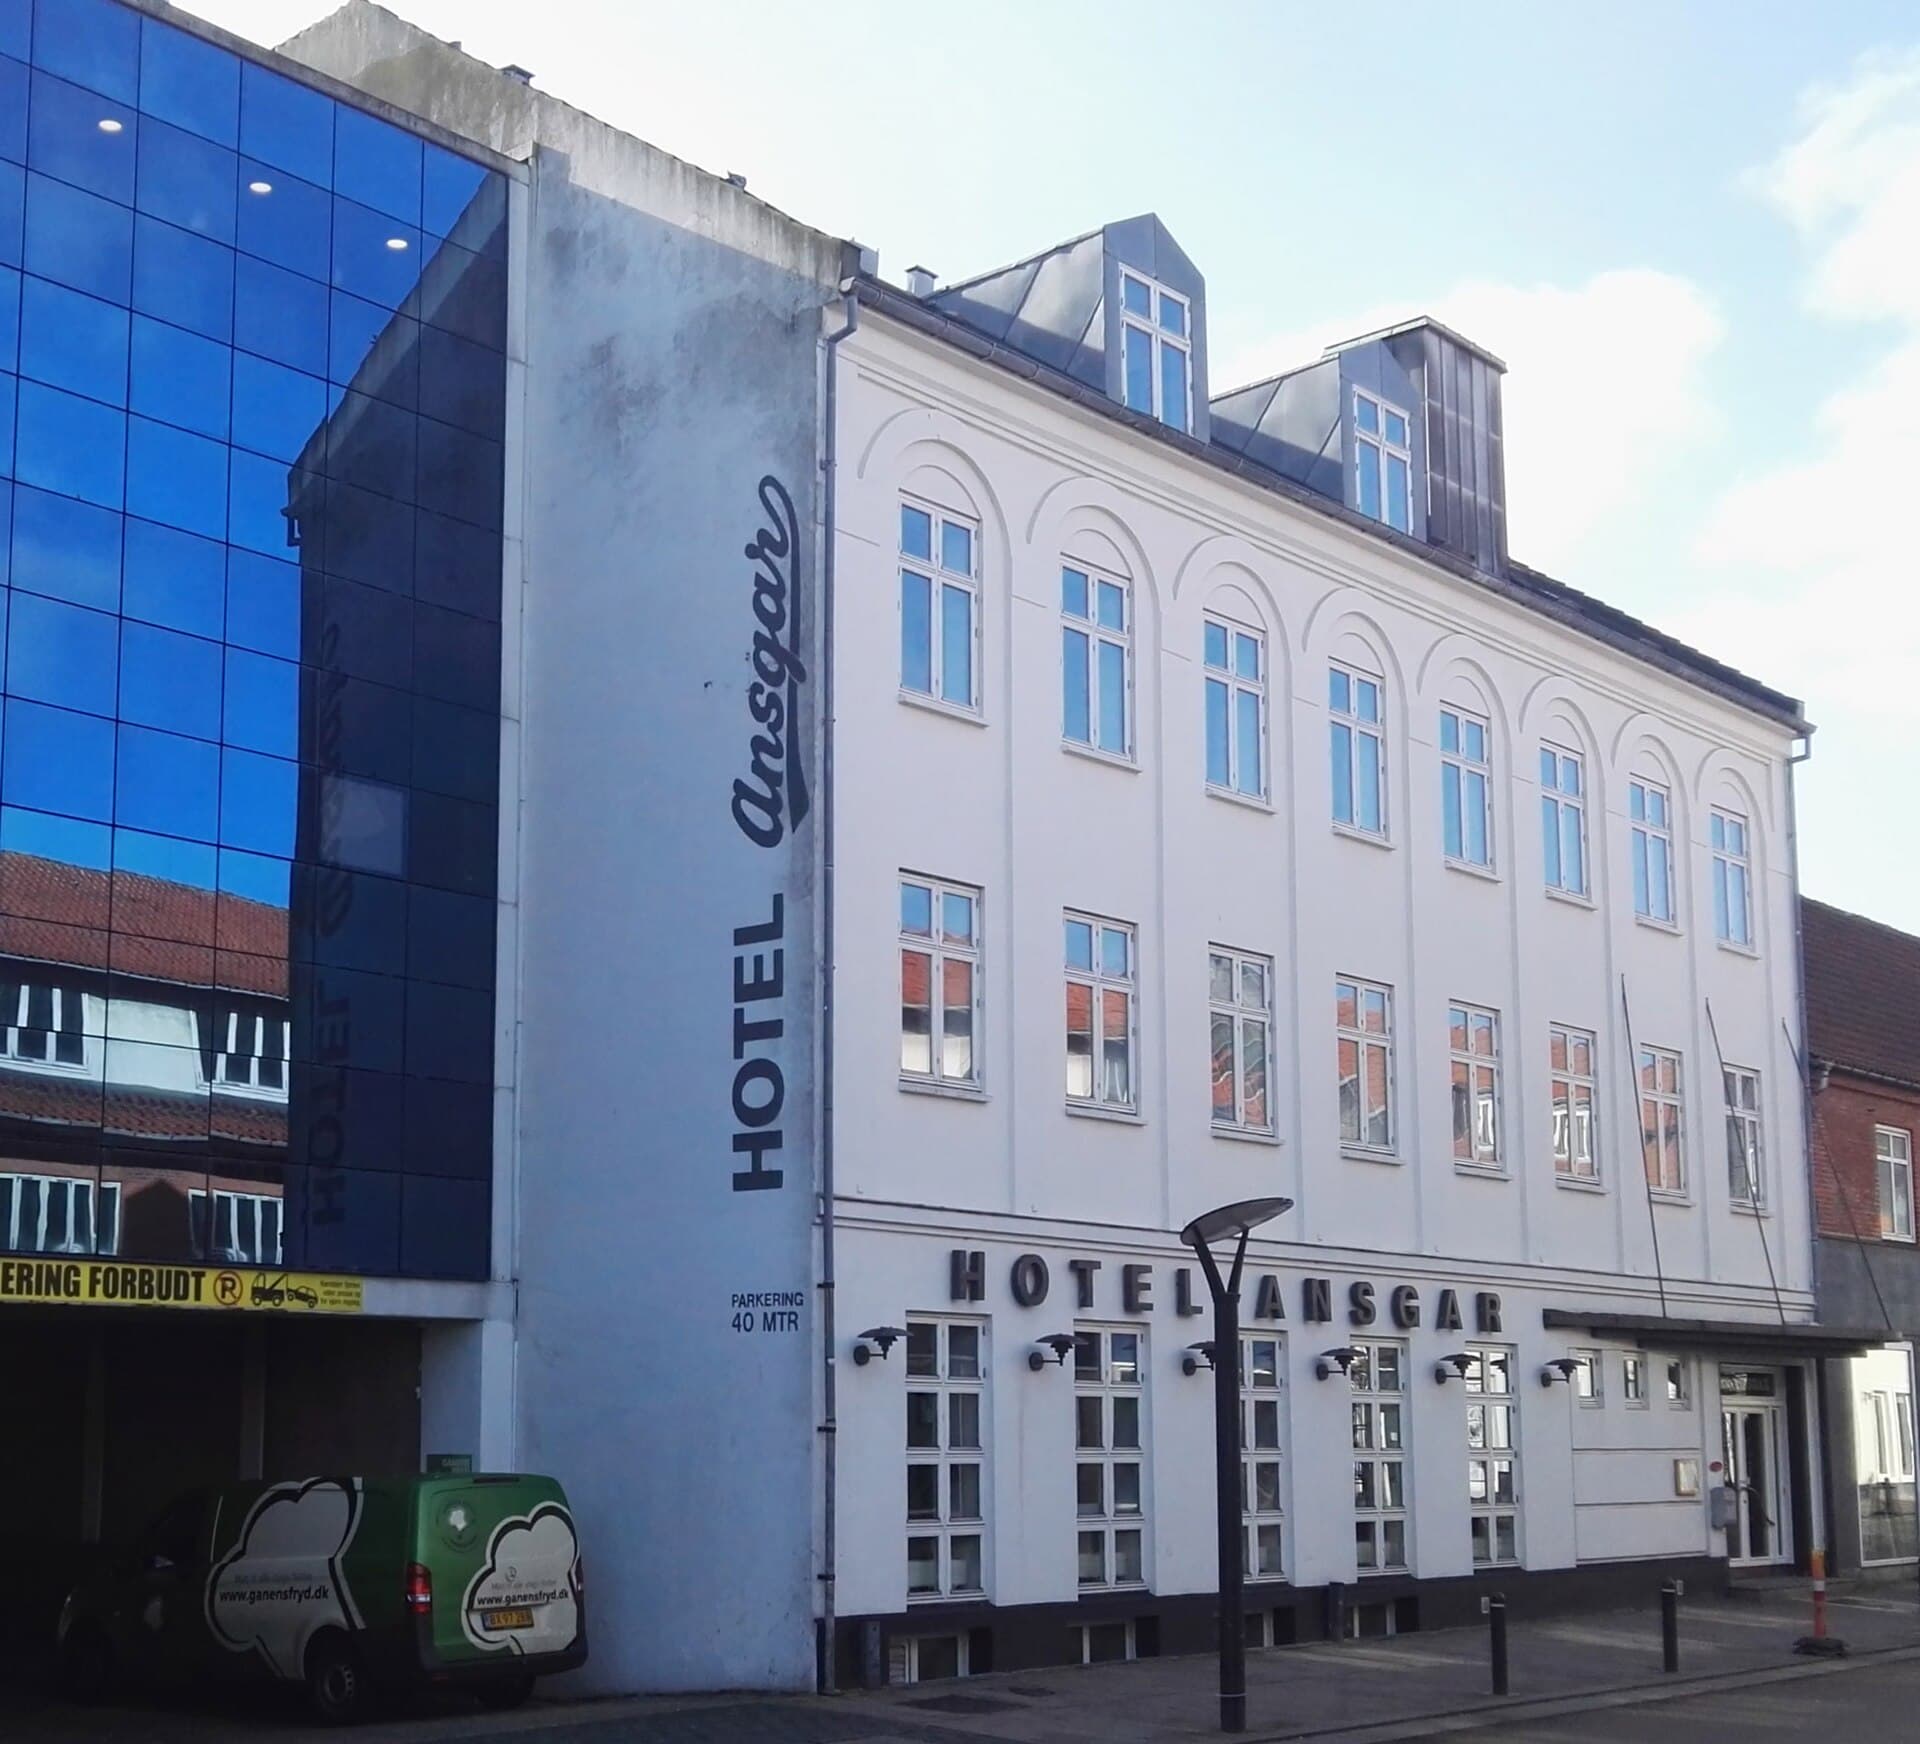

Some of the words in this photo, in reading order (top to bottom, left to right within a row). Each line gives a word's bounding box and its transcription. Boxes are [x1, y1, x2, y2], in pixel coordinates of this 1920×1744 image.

[732, 892, 785, 1193] HOTEL
[1, 1262, 81, 1299] ERING
[89, 1265, 206, 1302] FORBUDT
[951, 1248, 1204, 1317] HOTEL
[1255, 1274, 1503, 1333] ANSGAR
[731, 1291, 805, 1308] PARKERING
[731, 1311, 754, 1333] 40
[762, 1311, 799, 1332] MTR
[218, 1585, 330, 1605] www.ganensfryd.dk
[476, 1588, 569, 1606] www.ganensfryd.dk
